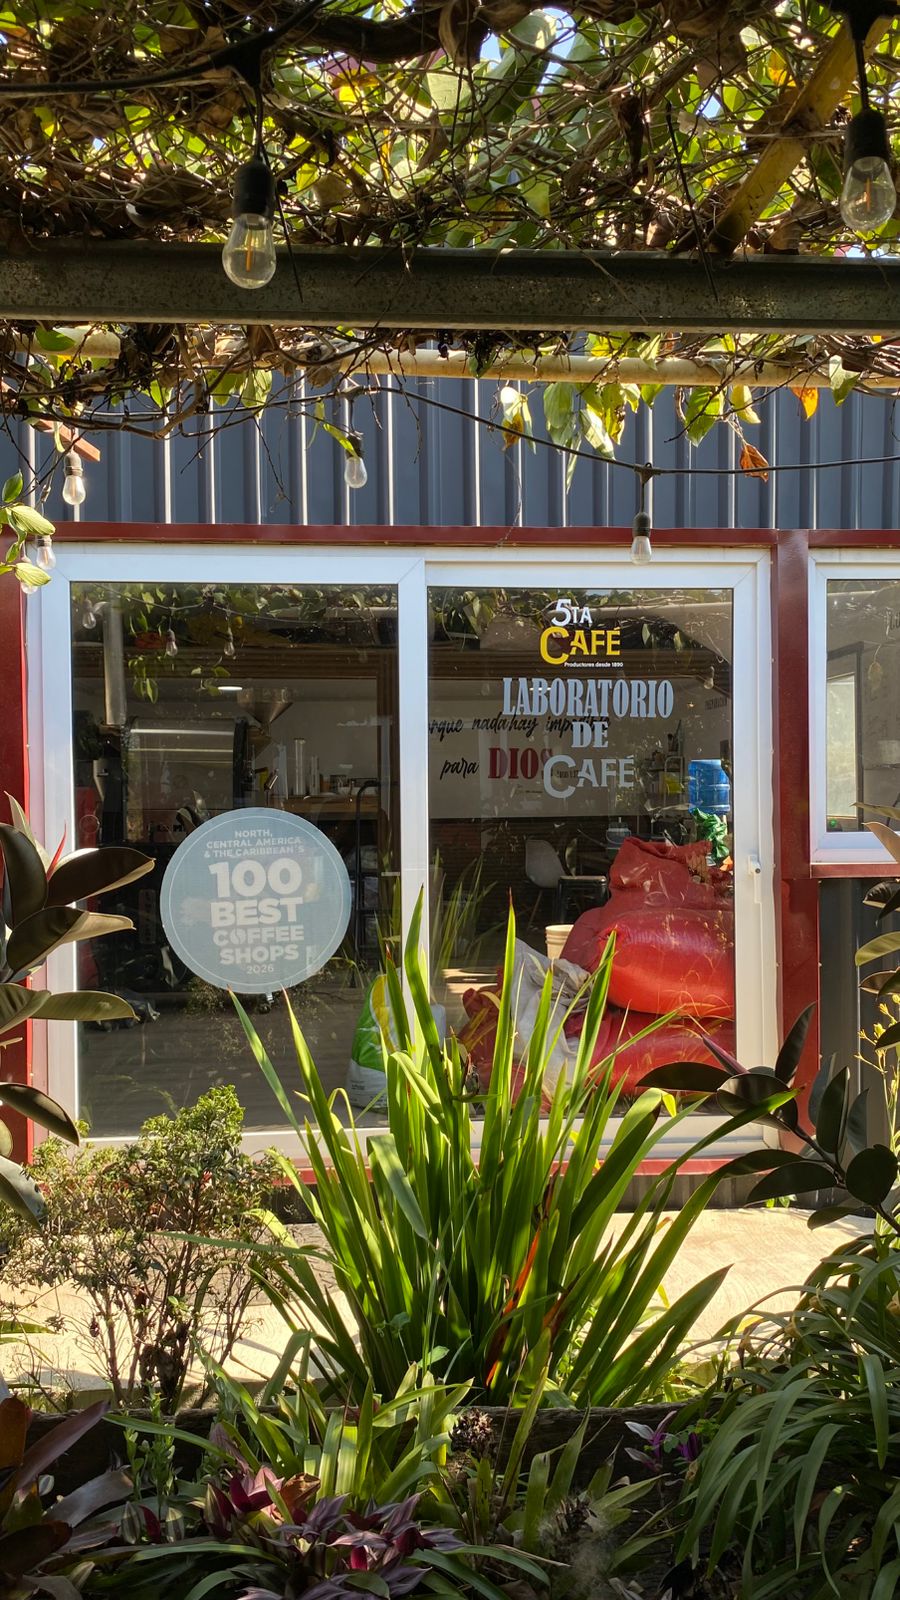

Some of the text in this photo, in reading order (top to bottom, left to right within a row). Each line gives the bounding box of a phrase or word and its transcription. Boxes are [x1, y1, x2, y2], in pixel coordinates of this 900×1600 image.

[540, 626, 621, 665] CAFÉ
[502, 677, 674, 719] LABORATORIO
[508, 709, 539, 738] hay
[571, 721, 609, 748] DE
[440, 757, 480, 780] para
[543, 754, 635, 799] CAFÉ
[206, 836, 302, 849] CENTRAL AMERICA
[234, 828, 273, 838] NORTH,
[203, 845, 305, 858] & THE CARIBBEAN'S
[208, 857, 303, 898] 100
[210, 896, 304, 928] BEST
[213, 924, 305, 947] COFFEE
[220, 943, 300, 965] SHOPS
[246, 963, 275, 975] 2026
